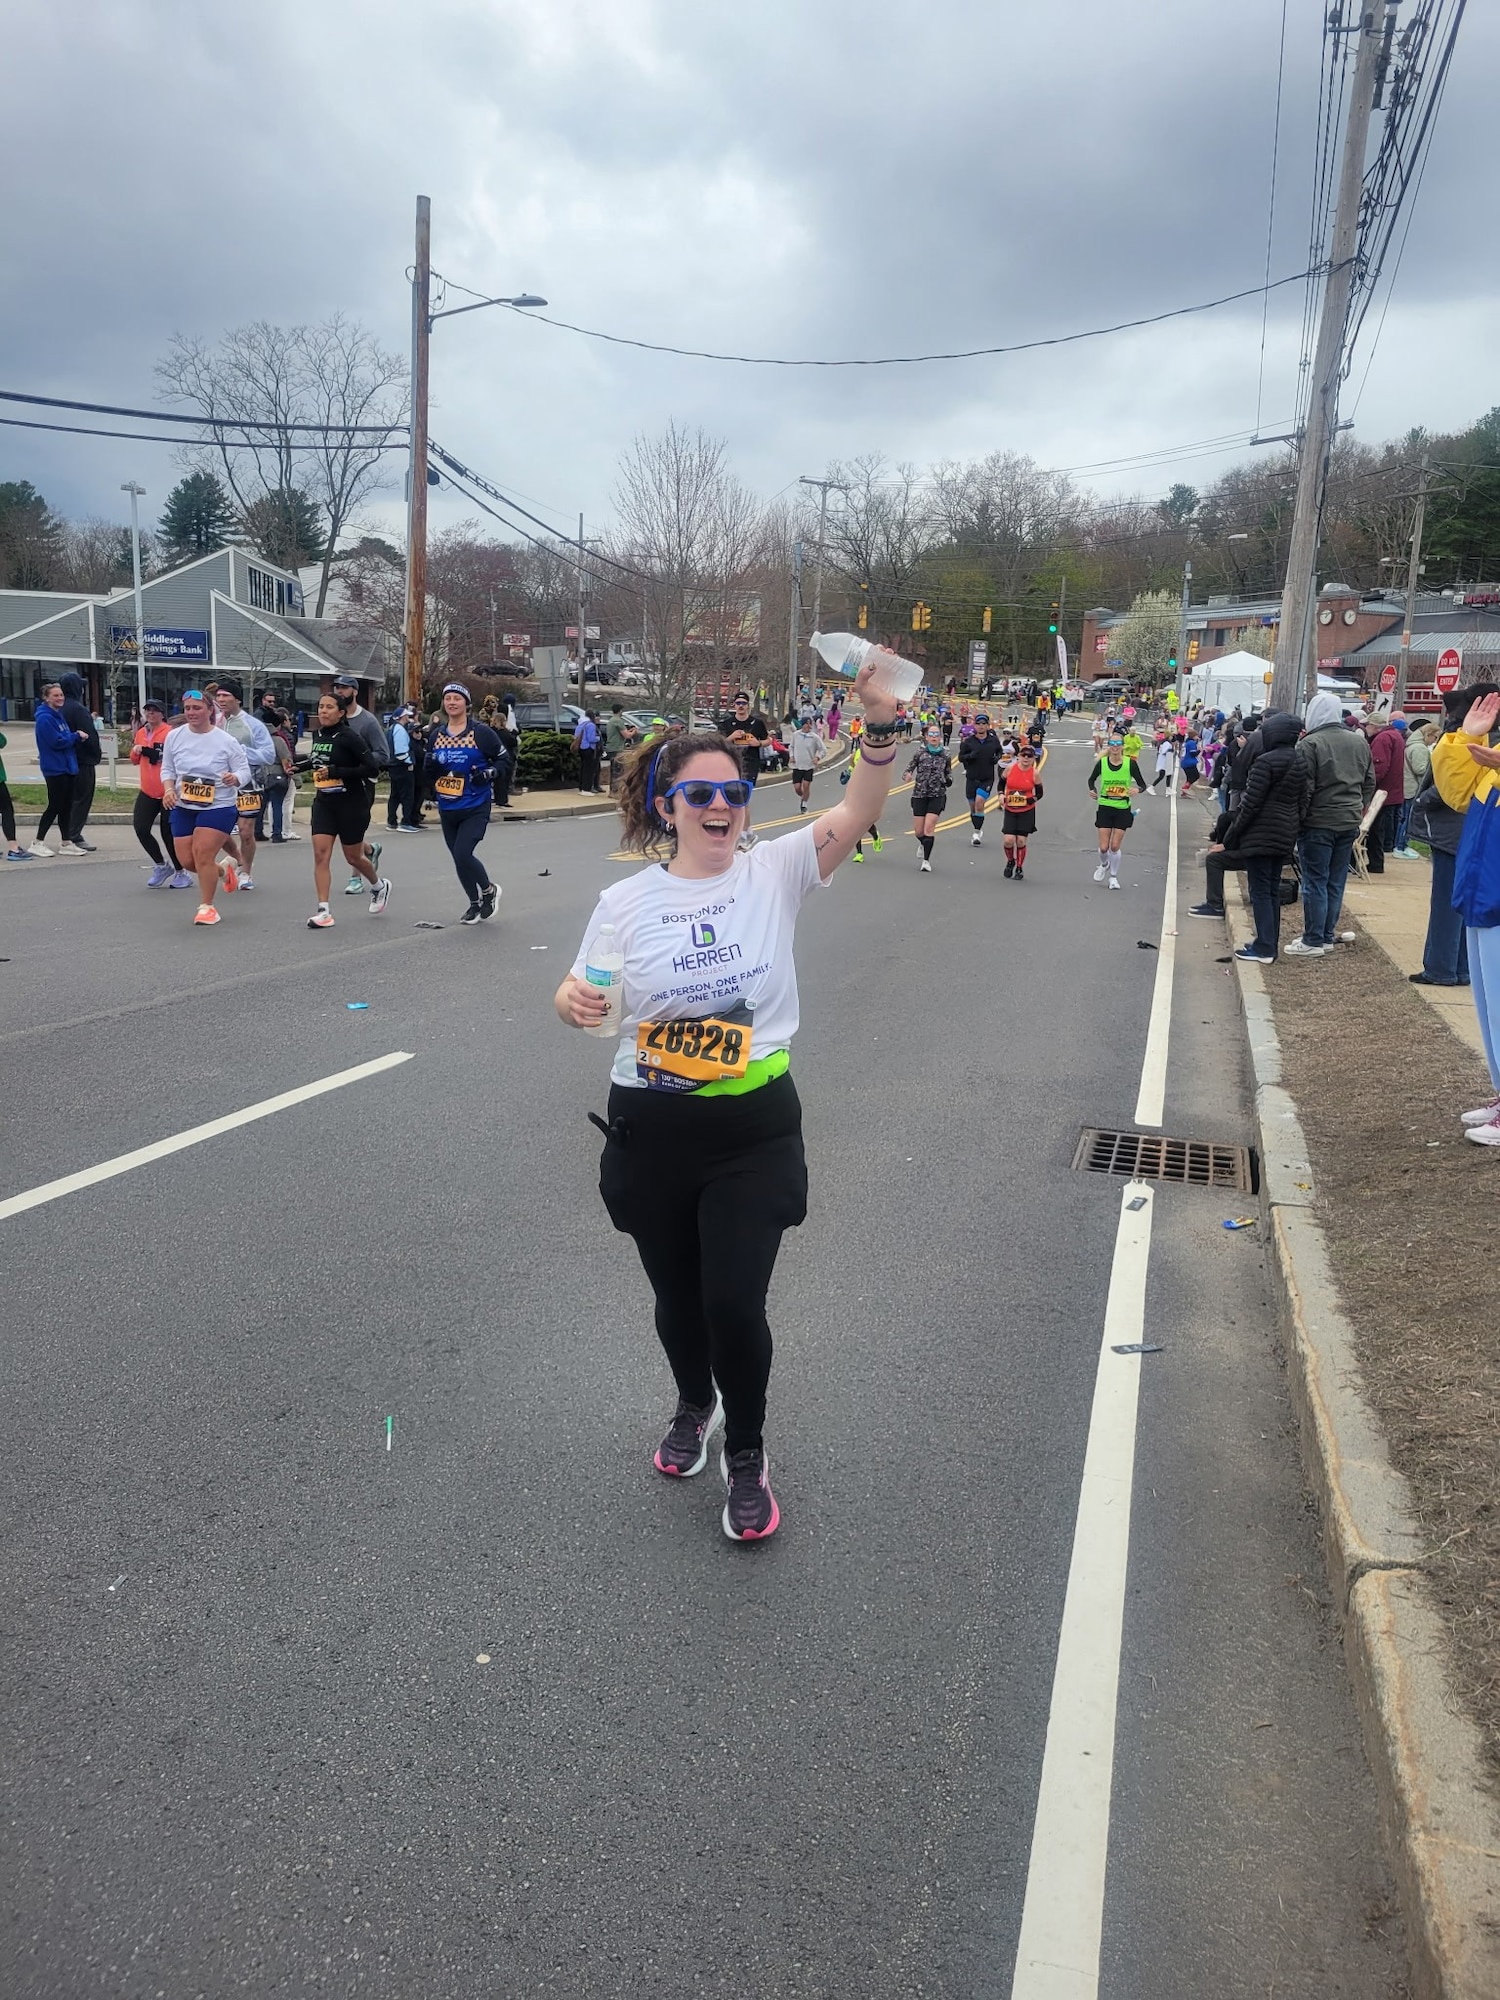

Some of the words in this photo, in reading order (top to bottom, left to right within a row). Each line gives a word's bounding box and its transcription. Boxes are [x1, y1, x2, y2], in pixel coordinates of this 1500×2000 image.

[144, 643, 178, 656] Savings
[180, 645, 203, 655] Bank
[1440, 657, 1448, 666] DO
[1449, 656, 1458, 665] NOT
[1381, 673, 1396, 685] STOP
[1439, 677, 1454, 686] ENTER
[184, 783, 212, 798] 28026
[661, 905, 710, 924] BOSTON
[691, 964, 729, 978] PROJECT
[650, 990, 670, 1003] ONE
[670, 981, 714, 998] PERSON.
[715, 975, 738, 988] ONE
[740, 961, 773, 982] FAMILY.
[686, 992, 710, 1004] ONE
[711, 985, 742, 1000] TEAM.
[645, 1020, 743, 1066] 28328
[639, 1051, 648, 1062] 2
